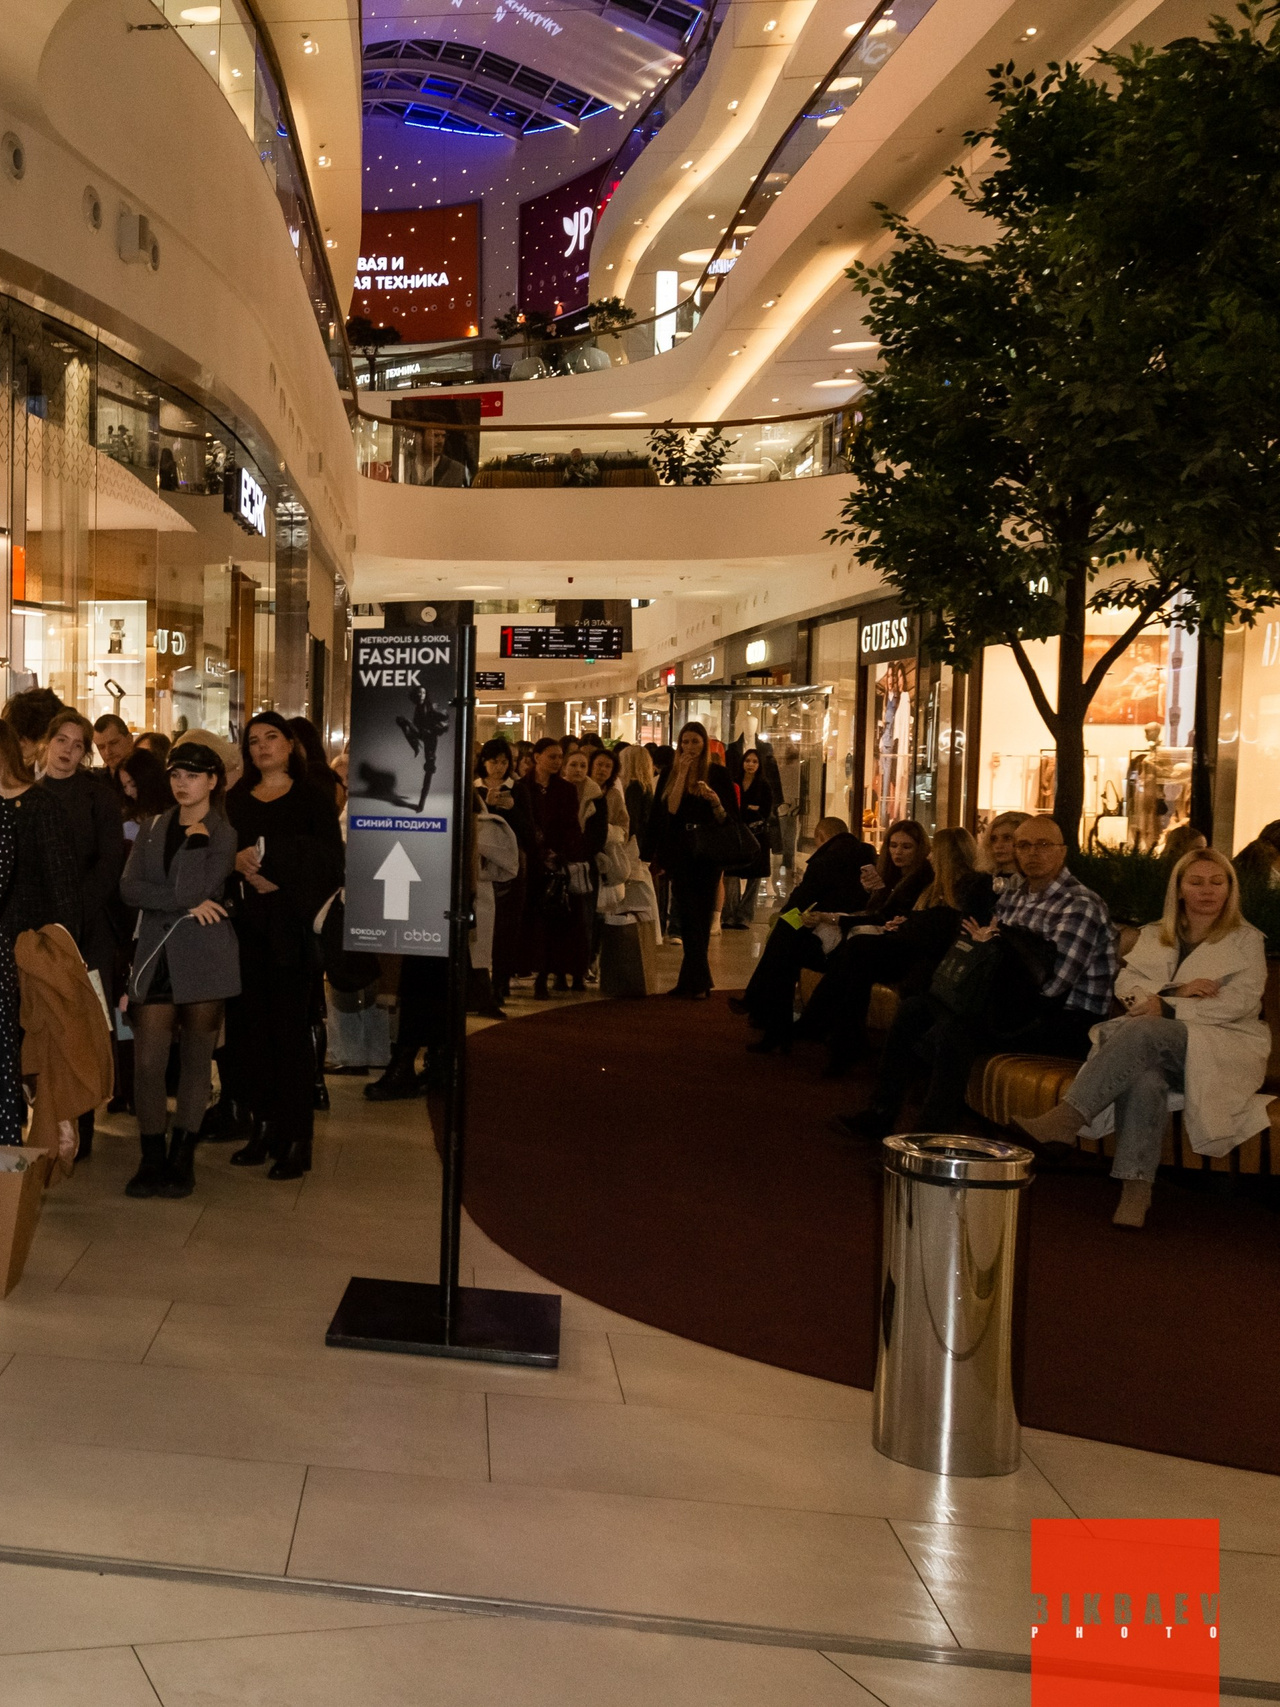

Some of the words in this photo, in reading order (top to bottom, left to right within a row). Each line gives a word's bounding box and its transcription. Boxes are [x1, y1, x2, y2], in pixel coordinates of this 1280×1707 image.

[391, 256, 404, 271] И
[375, 271, 449, 291] ТЕХНИКА
[360, 635, 412, 644] METROPOLIS
[414, 635, 420, 643] &
[422, 635, 451, 643] SOKOL
[861, 616, 908, 654] GUESS
[358, 647, 450, 665] FASHION
[358, 669, 421, 687] WEEK
[356, 818, 393, 828] СИНИЙ
[395, 820, 441, 830] ПОДИУМ
[350, 927, 387, 936] SOKOLOV
